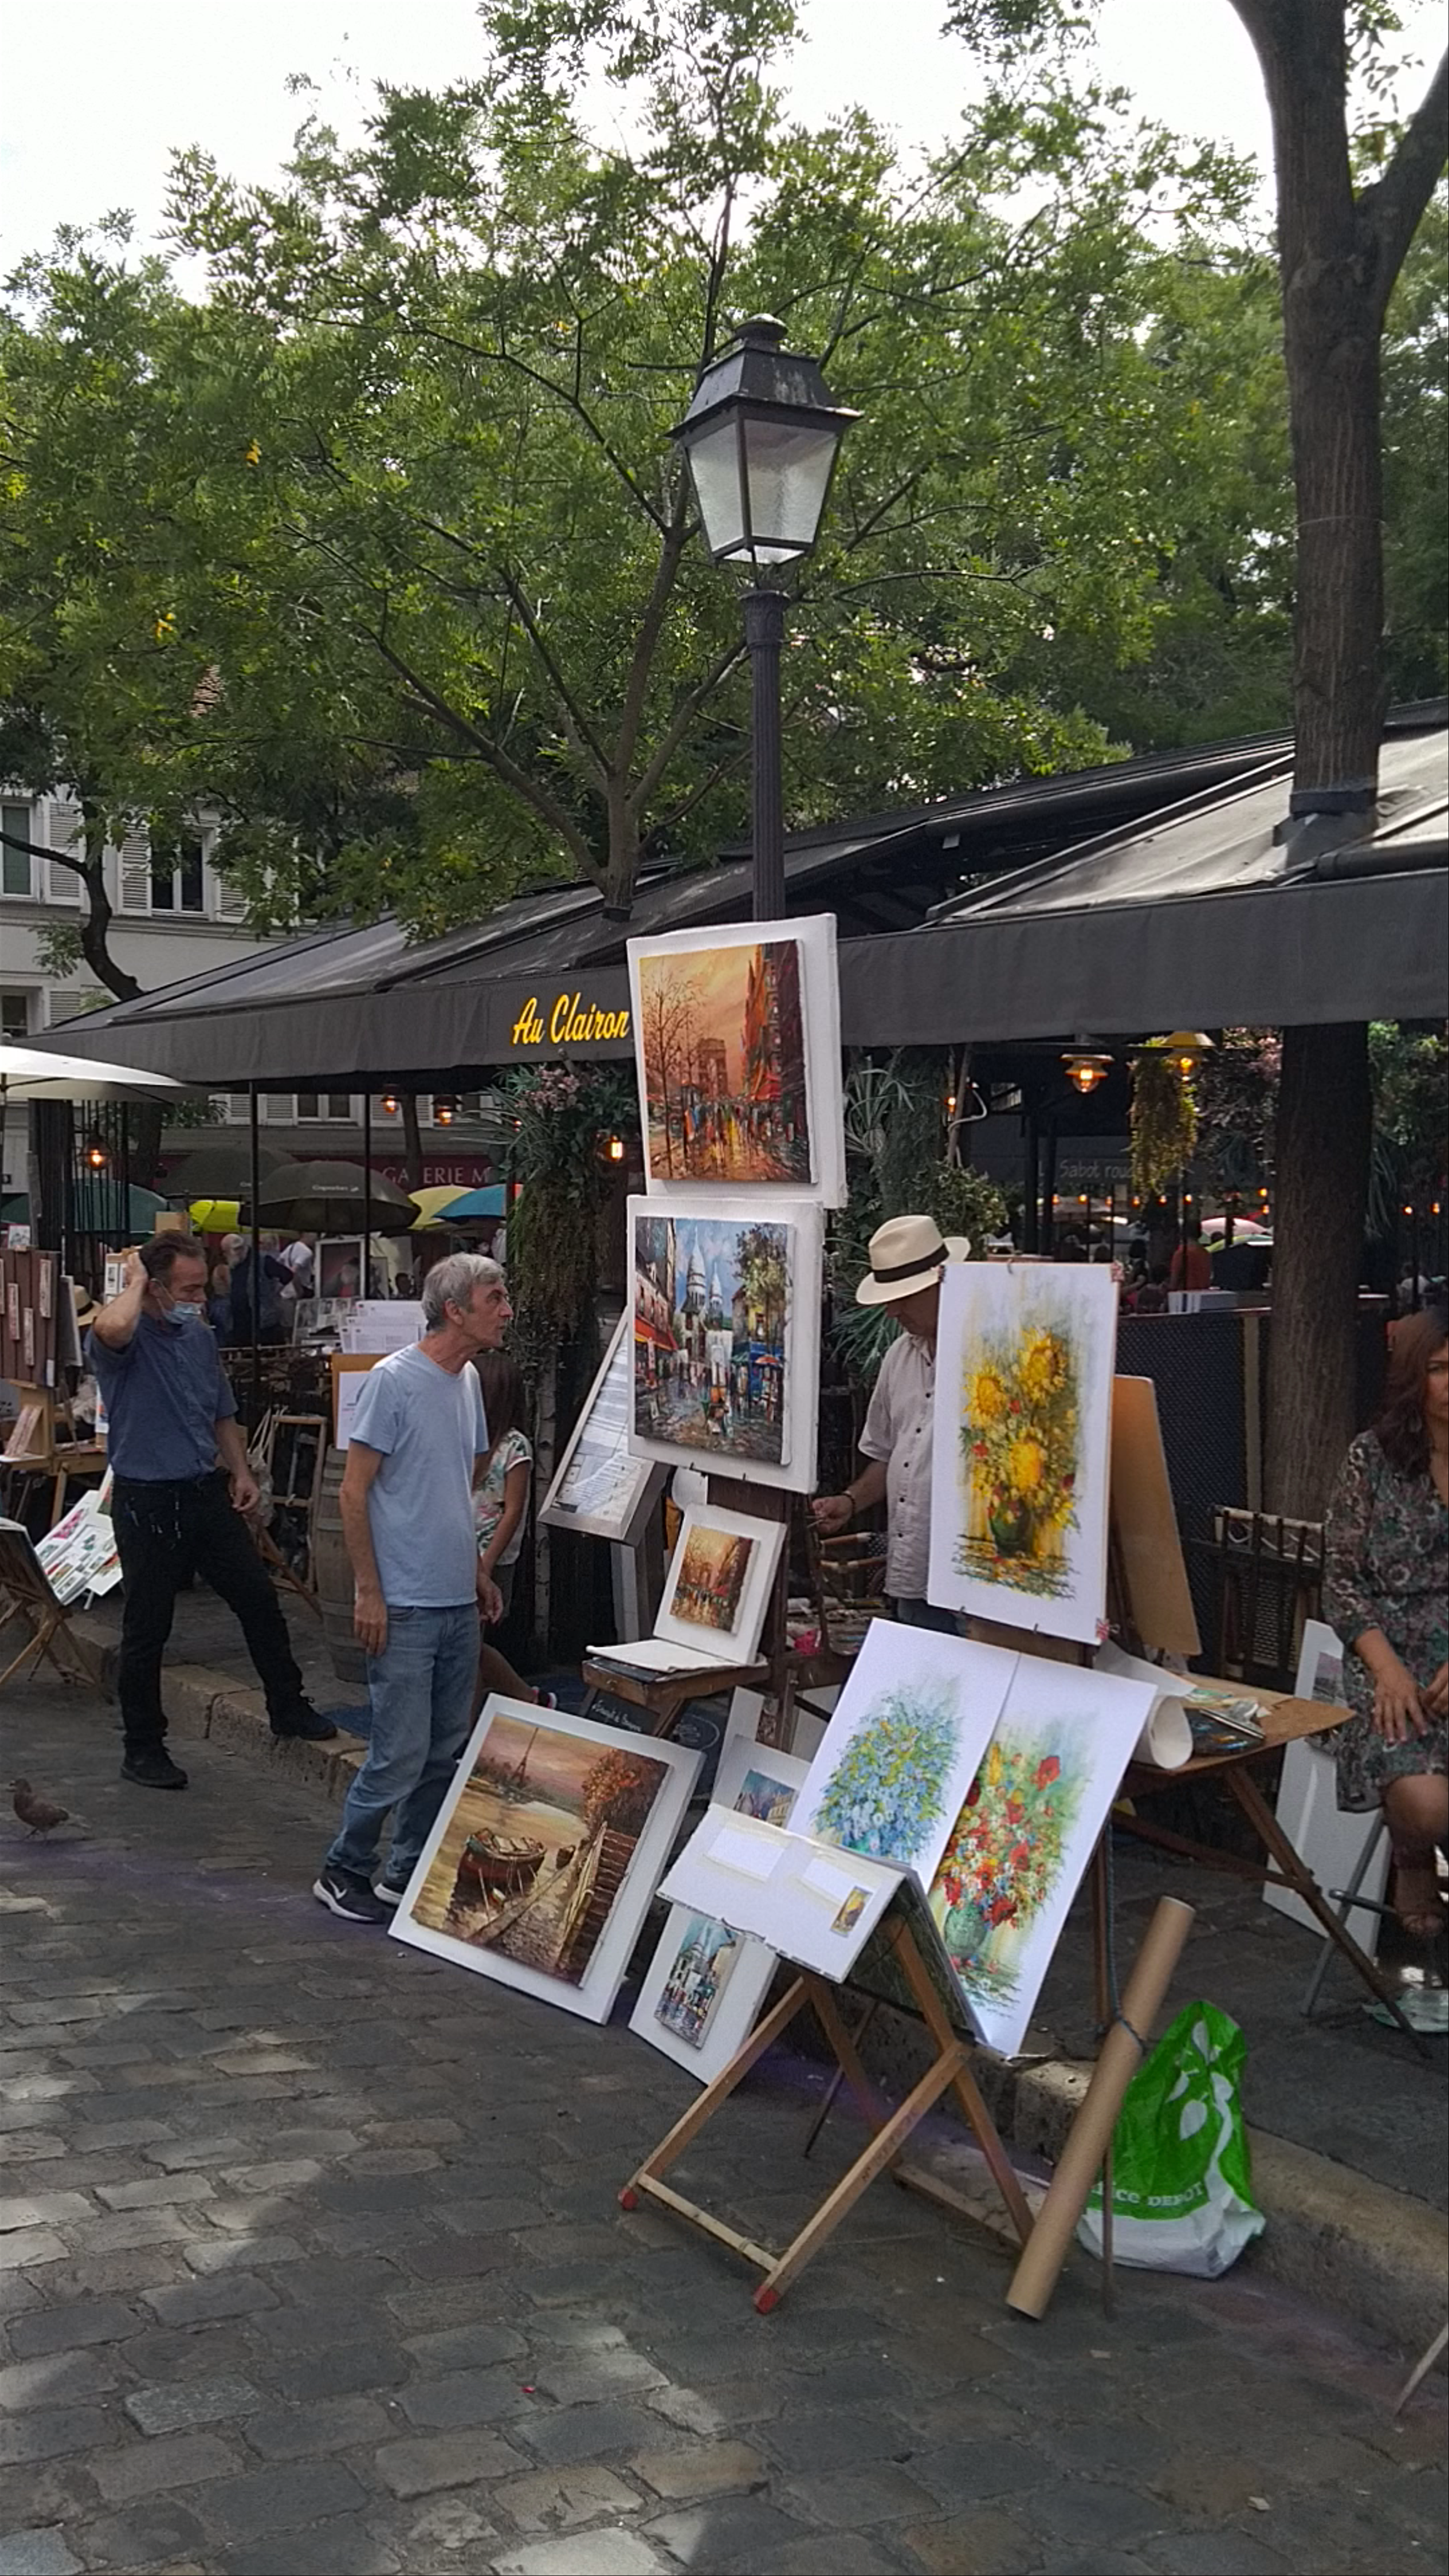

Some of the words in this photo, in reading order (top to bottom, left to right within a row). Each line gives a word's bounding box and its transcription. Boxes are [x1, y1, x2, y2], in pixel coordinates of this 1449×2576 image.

[513, 997, 545, 1044] Au
[551, 992, 630, 1044] Clairon
[382, 1166, 464, 1183] GAERIE
[1060, 1160, 1101, 1178] Sabot
[1148, 2181, 1203, 2207] DEPOT
